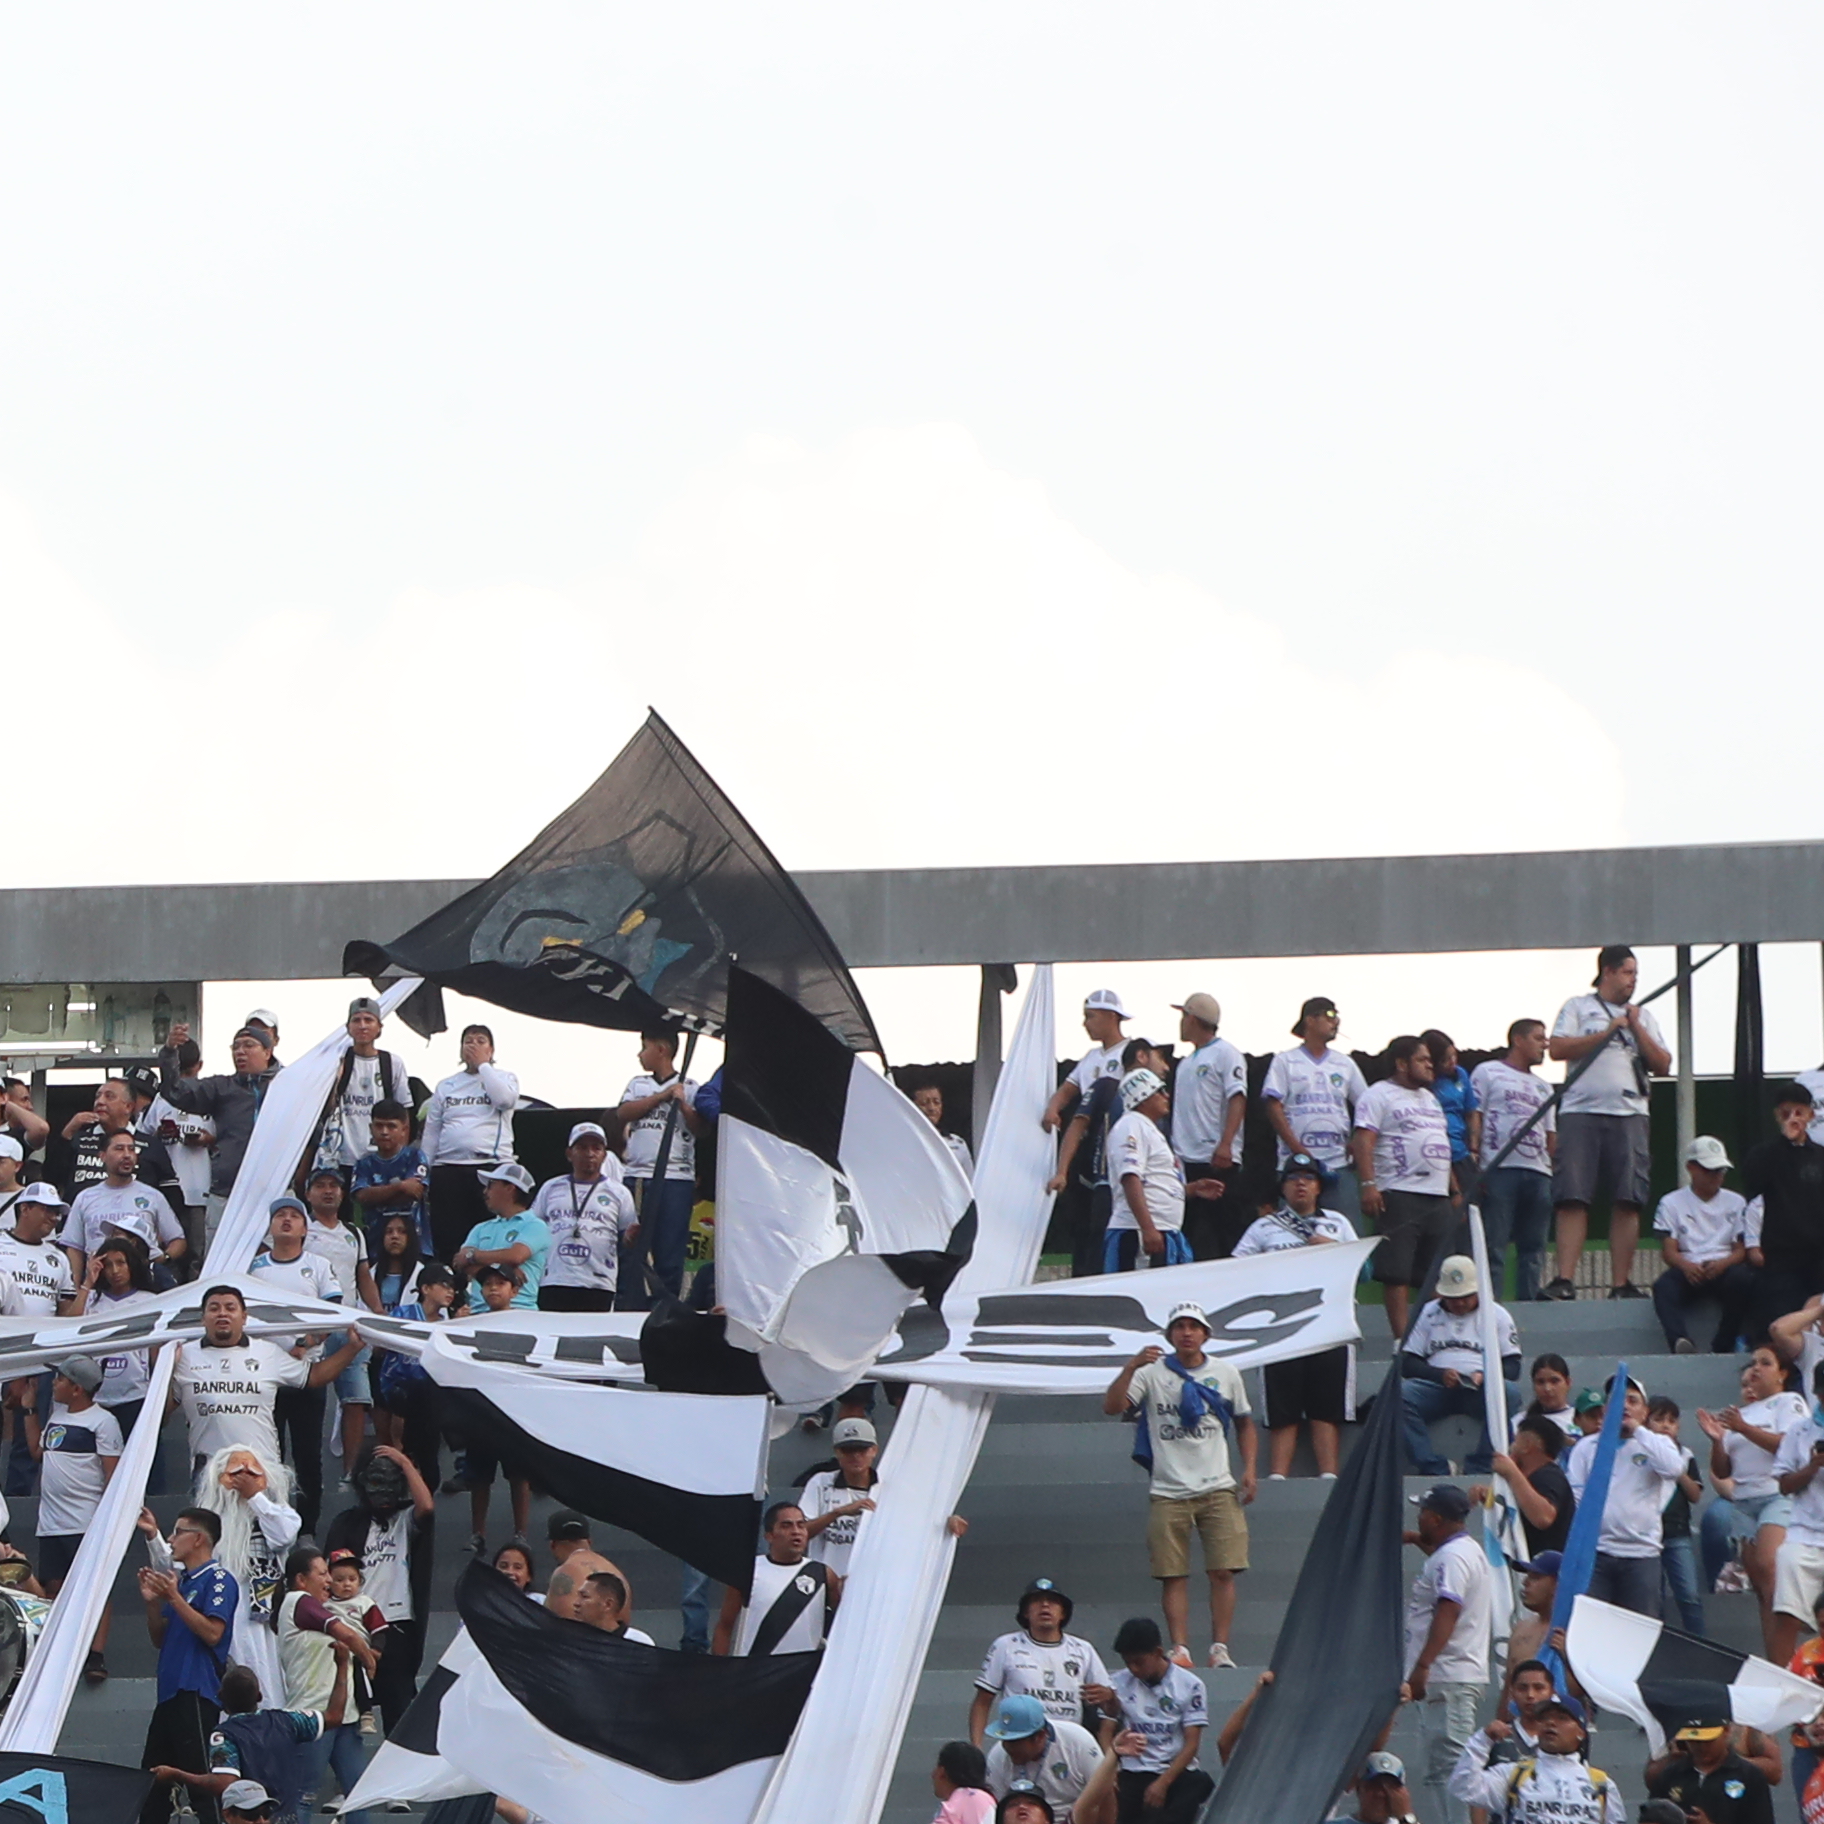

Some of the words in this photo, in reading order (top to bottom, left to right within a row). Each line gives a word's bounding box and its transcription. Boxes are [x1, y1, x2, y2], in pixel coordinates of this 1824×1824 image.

[547, 1209, 604, 1223] BANRURA
[11, 1271, 58, 1288] ANRURA
[193, 1381, 261, 1395] BANRURAL
[208, 1403, 260, 1416] GANA777
